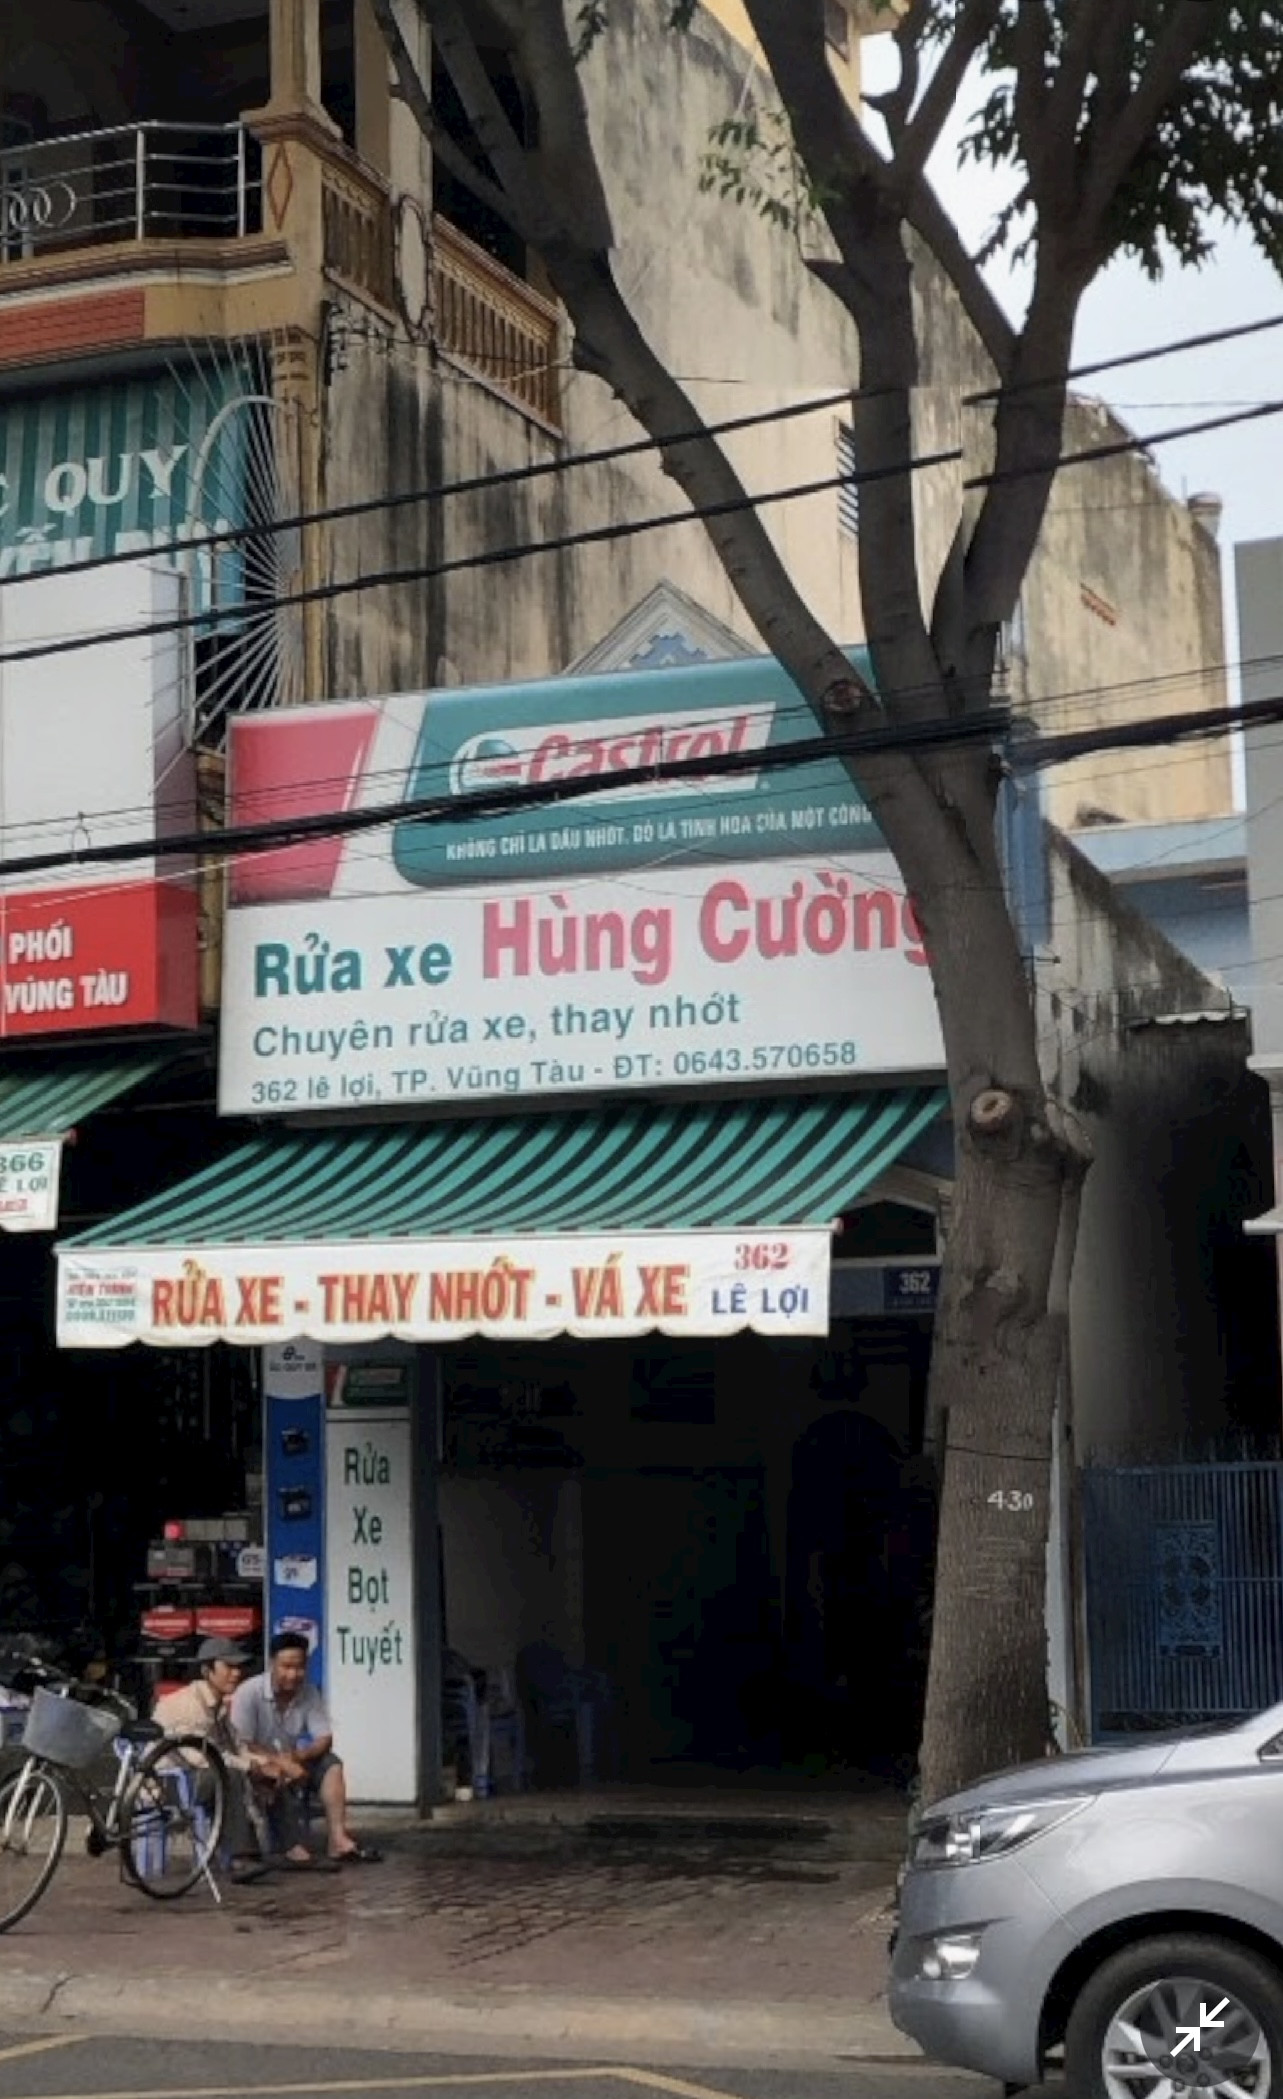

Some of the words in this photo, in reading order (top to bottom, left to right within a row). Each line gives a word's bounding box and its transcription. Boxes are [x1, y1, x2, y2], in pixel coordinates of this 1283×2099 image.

[44, 445, 188, 515] QUY
[528, 715, 751, 784] Castrol
[720, 814, 752, 836] HOA
[8, 918, 73, 965] PHỐI
[254, 933, 362, 998] Rửa
[384, 943, 451, 987] xe
[483, 895, 672, 985] Hùng
[79, 967, 129, 1008] TÀU
[252, 1020, 394, 1061] Chuyên
[409, 1010, 468, 1046] rửa
[482, 1014, 536, 1044] xe,
[550, 1003, 635, 1041] thay
[650, 992, 741, 1029] nhớt
[251, 1081, 297, 1104] 362
[308, 1075, 330, 1099] lê
[341, 1073, 381, 1102] lợi,
[392, 1070, 435, 1094] TP.
[448, 1066, 520, 1093] Vũng
[531, 1058, 585, 1085] Tàu
[613, 1053, 663, 1079] ĐT:
[673, 1041, 856, 1076] 0643.570658
[734, 1243, 790, 1271] 362
[152, 1258, 227, 1327] RỬA
[235, 1275, 285, 1326] XE
[318, 1271, 419, 1325] THAY
[429, 1255, 536, 1323] NHỚT
[572, 1252, 628, 1319] VÁ
[635, 1263, 690, 1317] XE
[711, 1283, 748, 1315] LÊ
[761, 1284, 809, 1319] LỢI
[900, 1271, 931, 1295] 362
[344, 1442, 391, 1486] Rửa
[987, 1489, 1034, 1512] 430
[352, 1506, 383, 1545] Xe
[348, 1567, 391, 1612] Bọt
[336, 1620, 403, 1676] Tuyết
